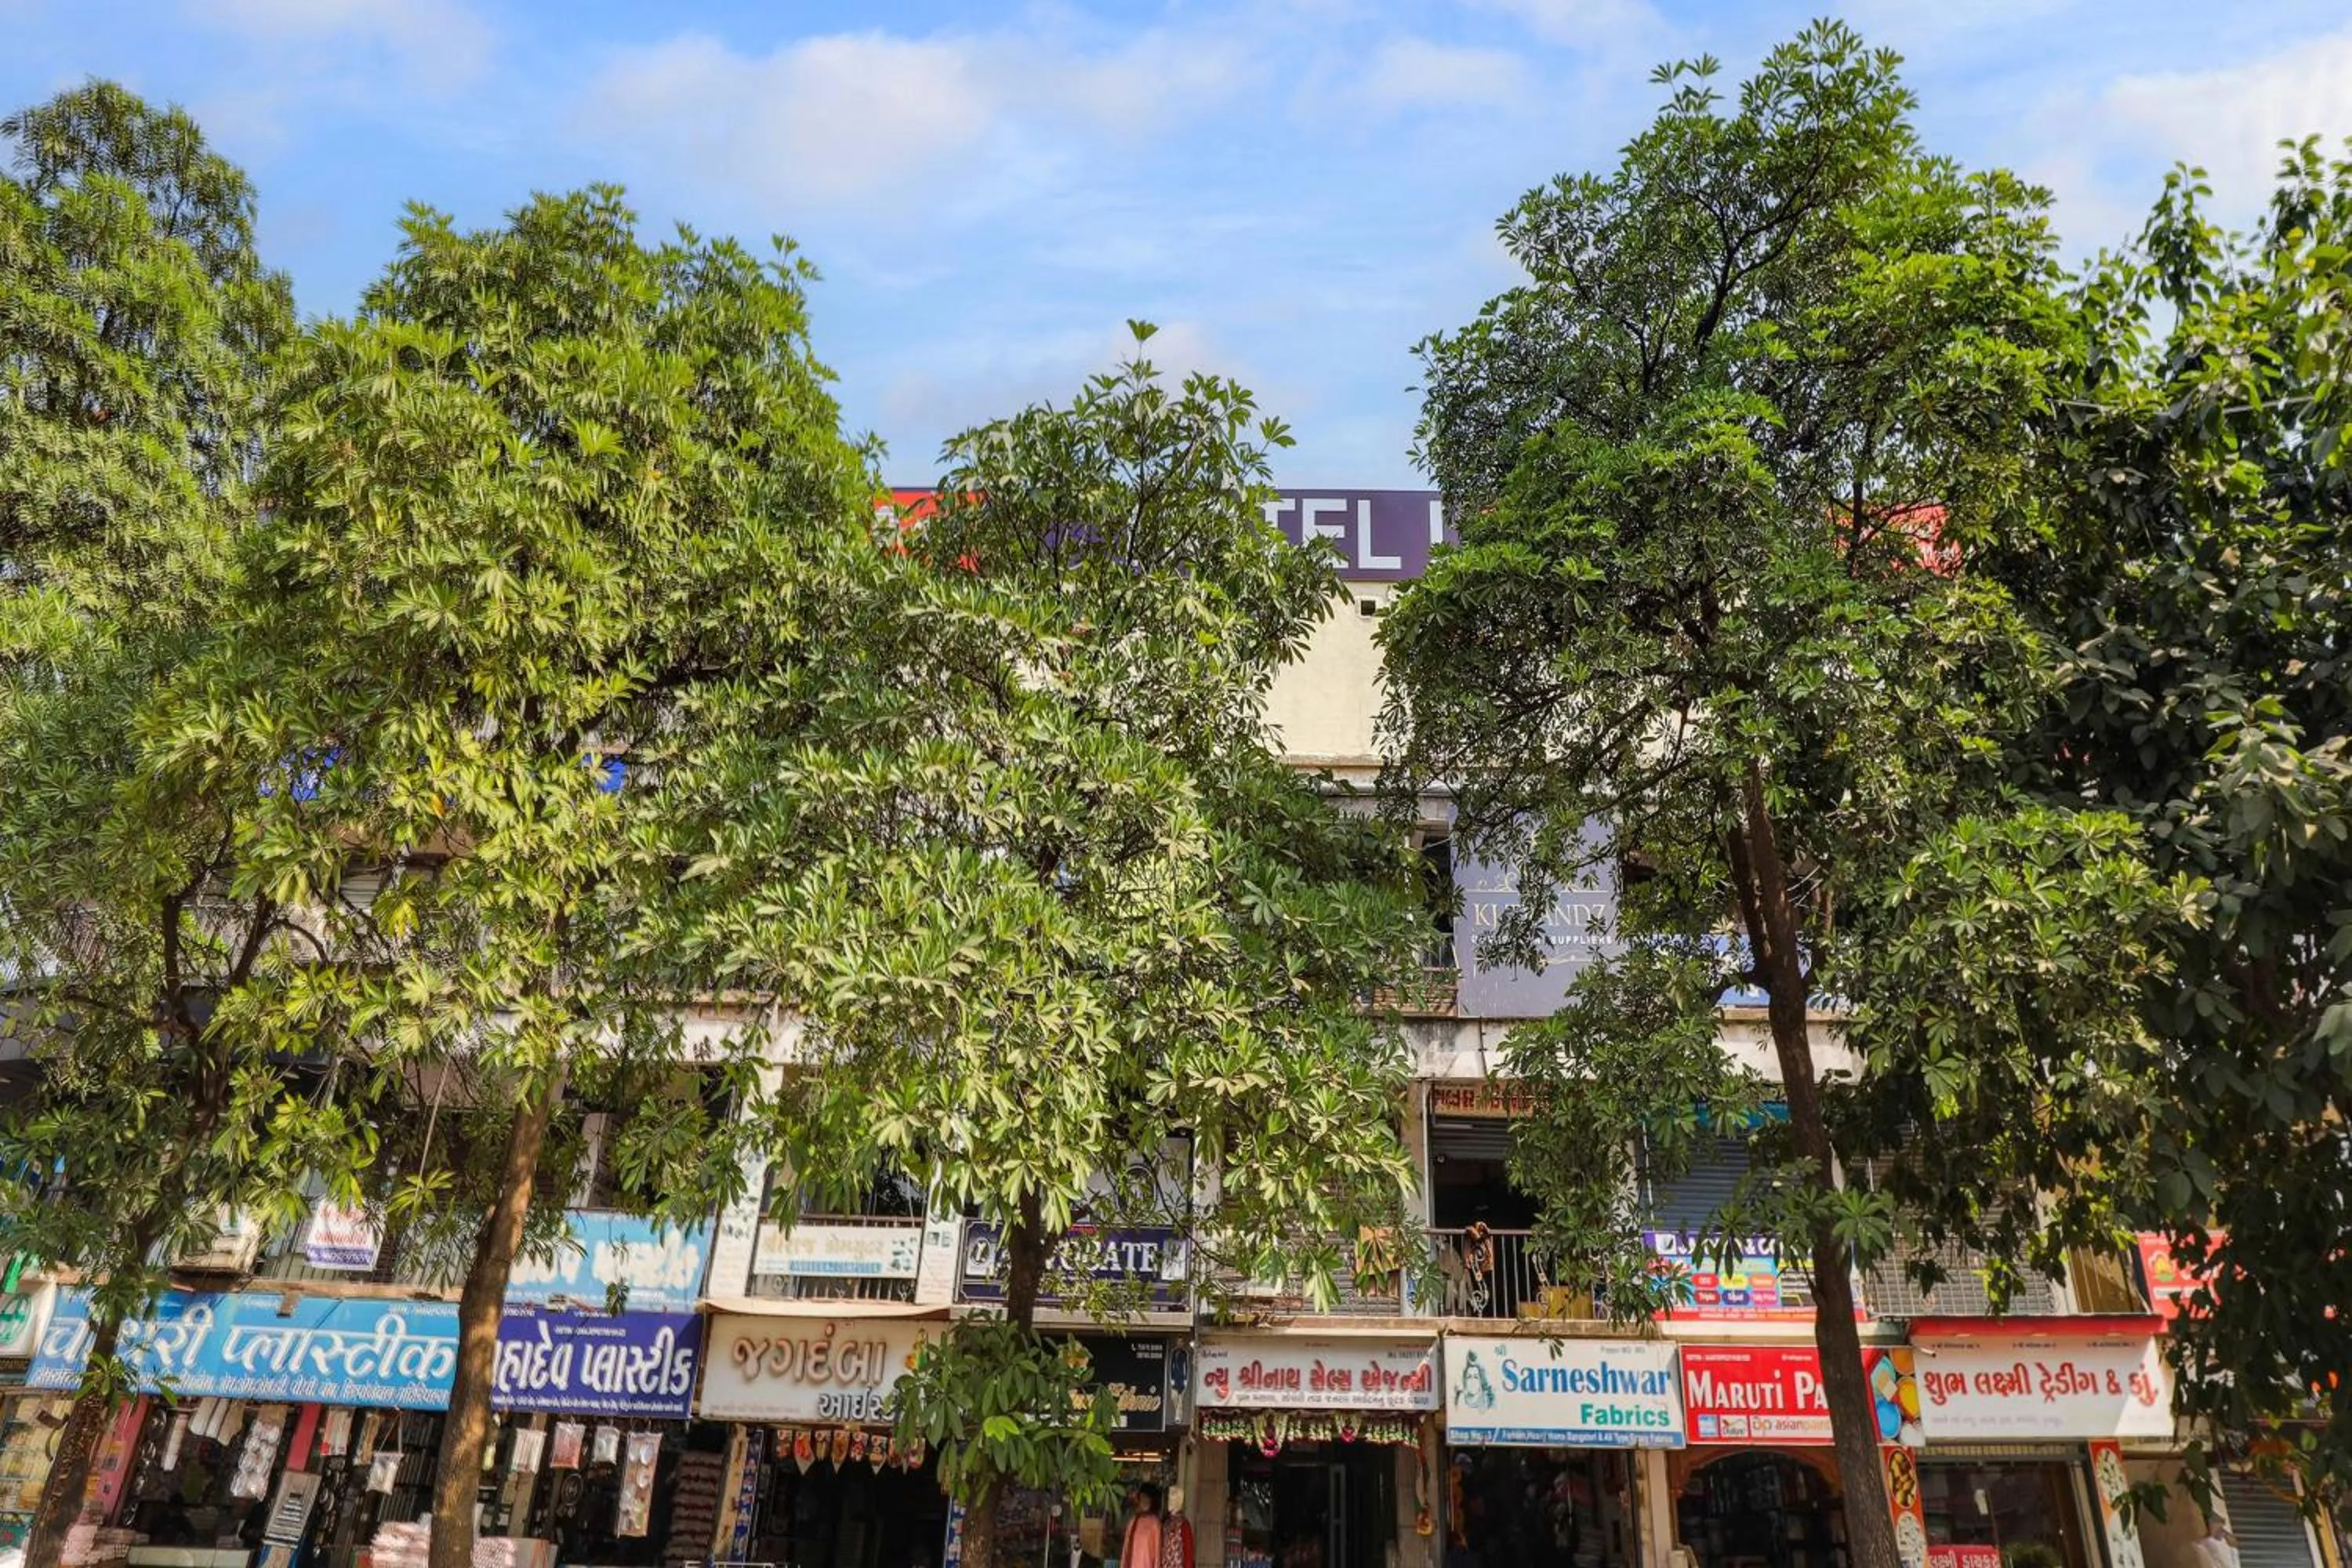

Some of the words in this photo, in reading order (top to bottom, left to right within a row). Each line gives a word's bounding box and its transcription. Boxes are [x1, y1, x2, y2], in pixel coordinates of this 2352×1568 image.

[1260, 498, 1402, 569] TEL
[1239, 1359, 1301, 1391] શ્રીનાથ
[1501, 1359, 1671, 1395] Sarneshwar
[1925, 1370, 1967, 1405] શુભ
[1974, 1363, 2032, 1398] લક્ષ્મી
[2107, 1370, 2122, 1396] &
[1581, 1403, 1670, 1427] Fabrics
